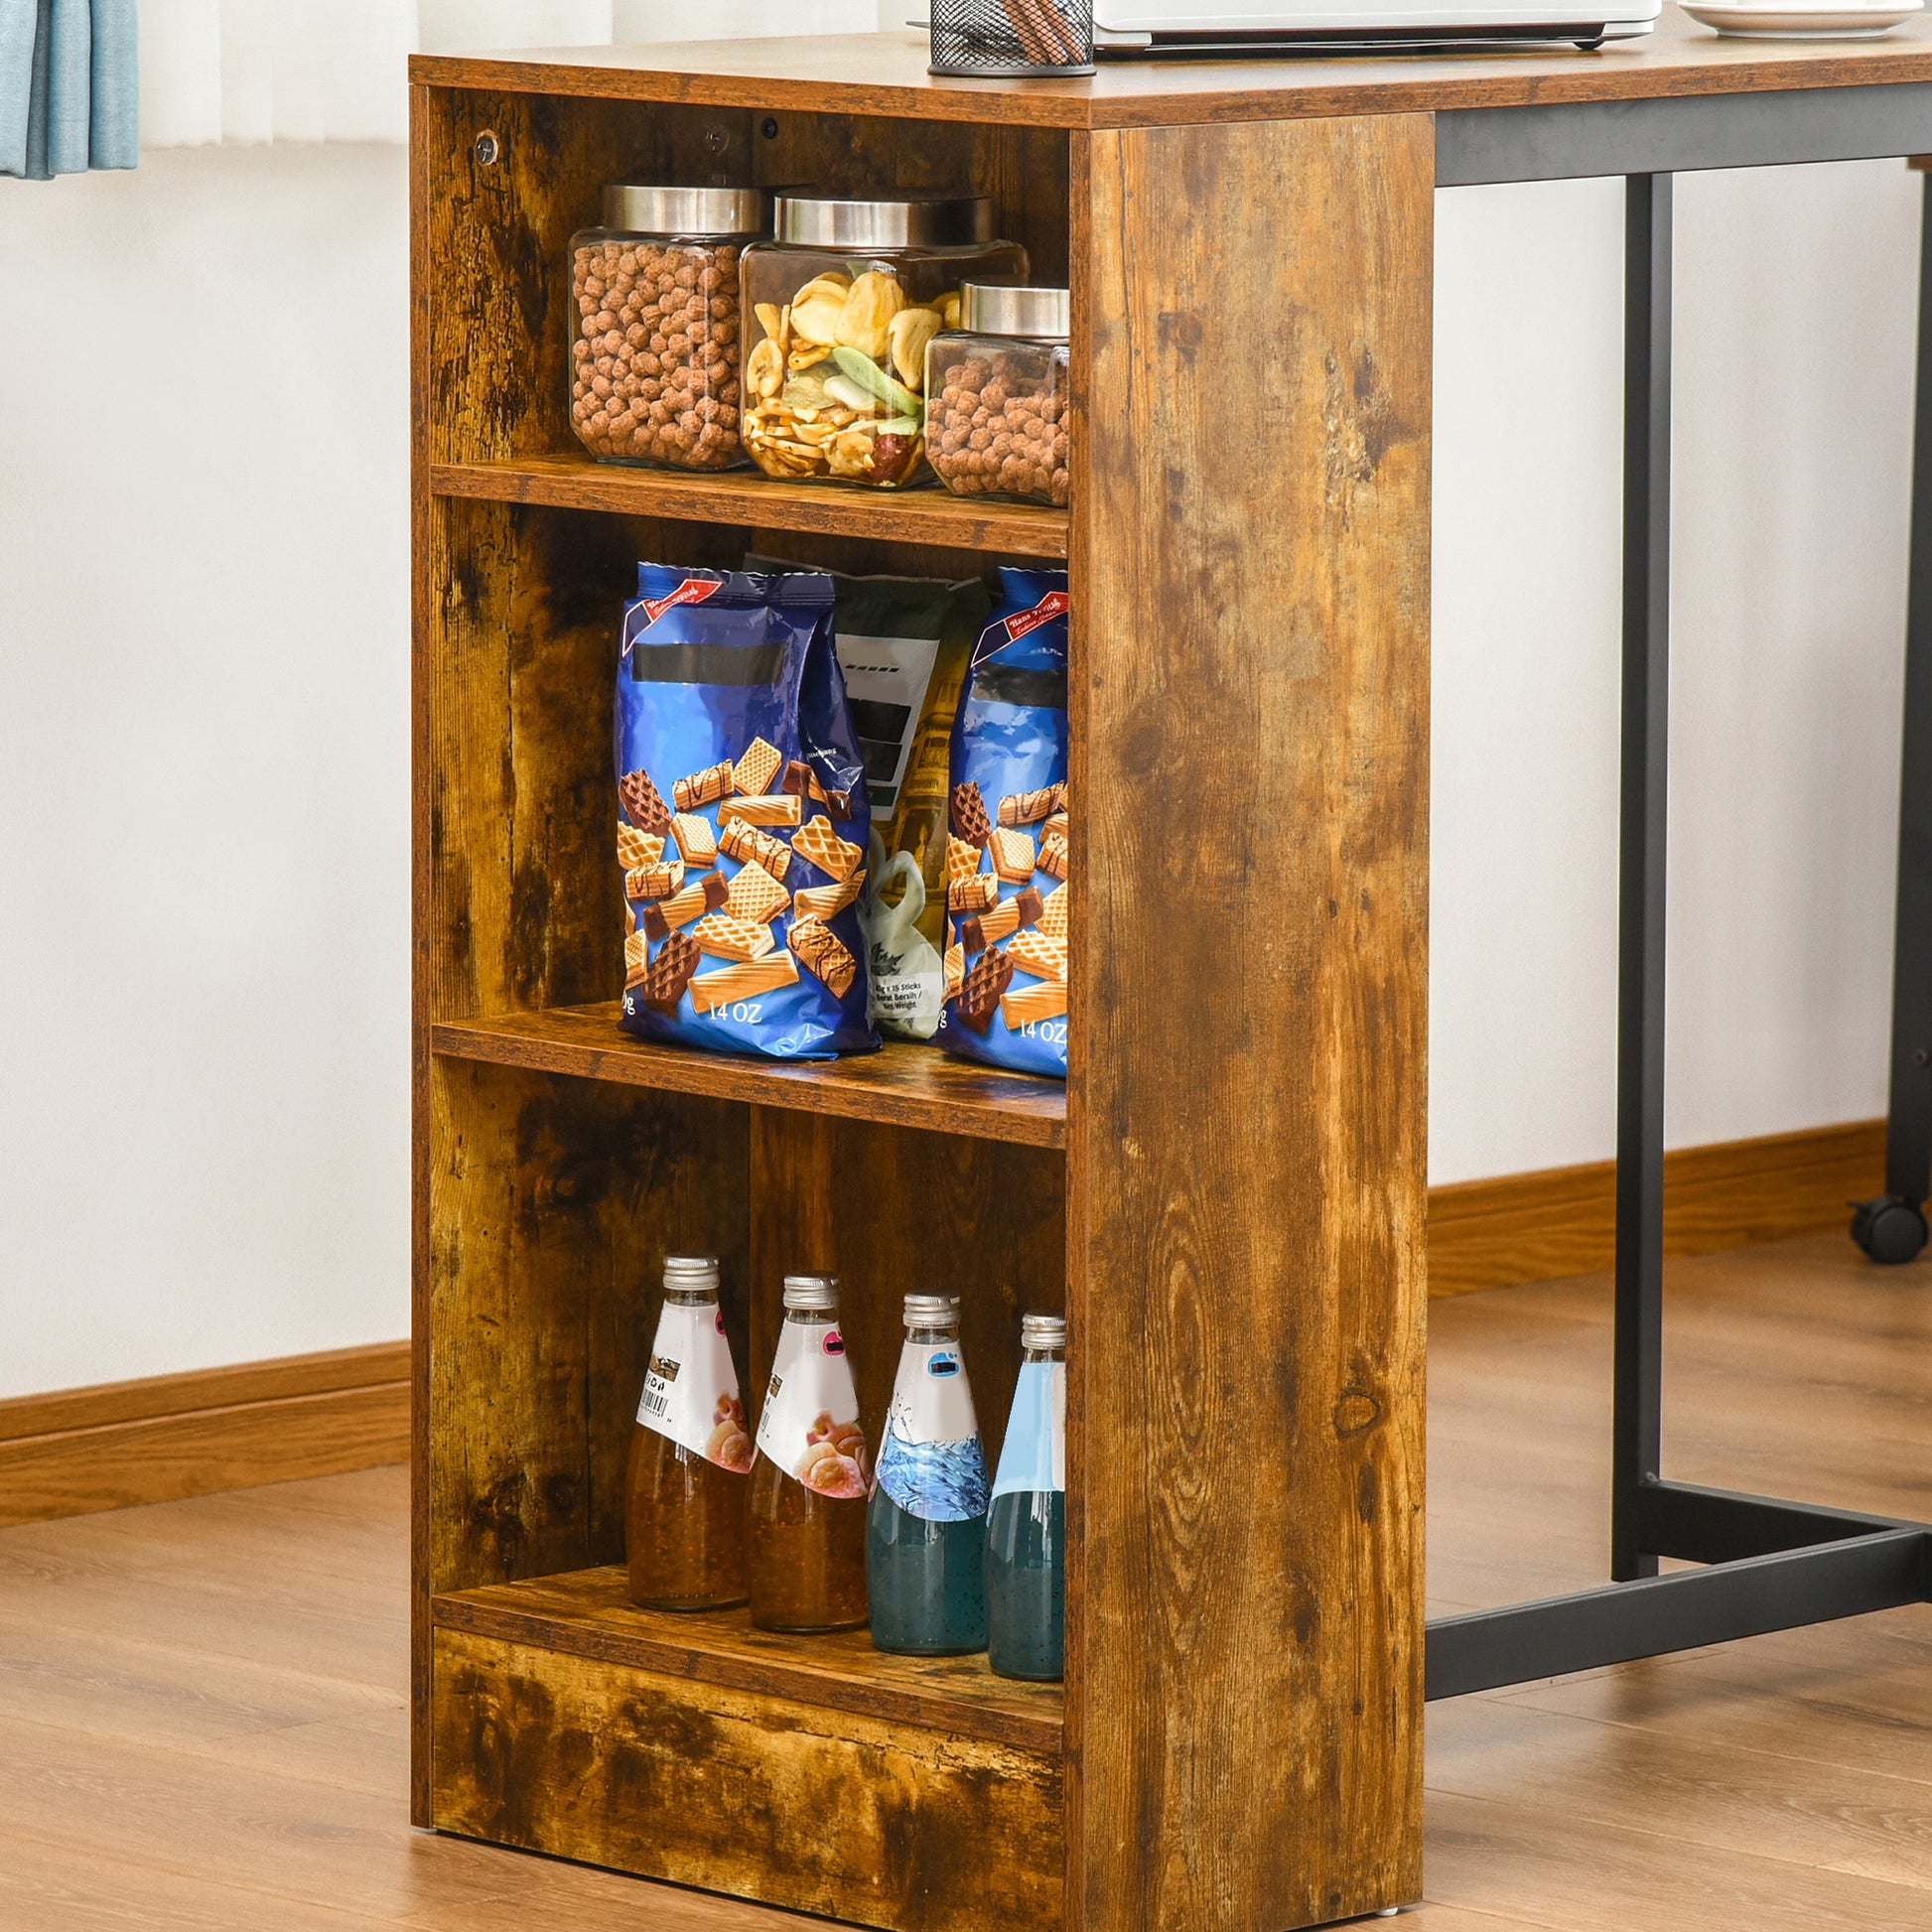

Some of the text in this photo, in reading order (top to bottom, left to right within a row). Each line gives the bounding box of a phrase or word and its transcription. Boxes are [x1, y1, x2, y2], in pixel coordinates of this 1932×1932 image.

[1009, 614, 1032, 627] Hans
[900, 982, 921, 991] Sticks
[894, 992, 917, 1001] Bersih
[709, 1001, 762, 1024] 14 OZ
[1020, 1019, 1067, 1044] 14 OZ
